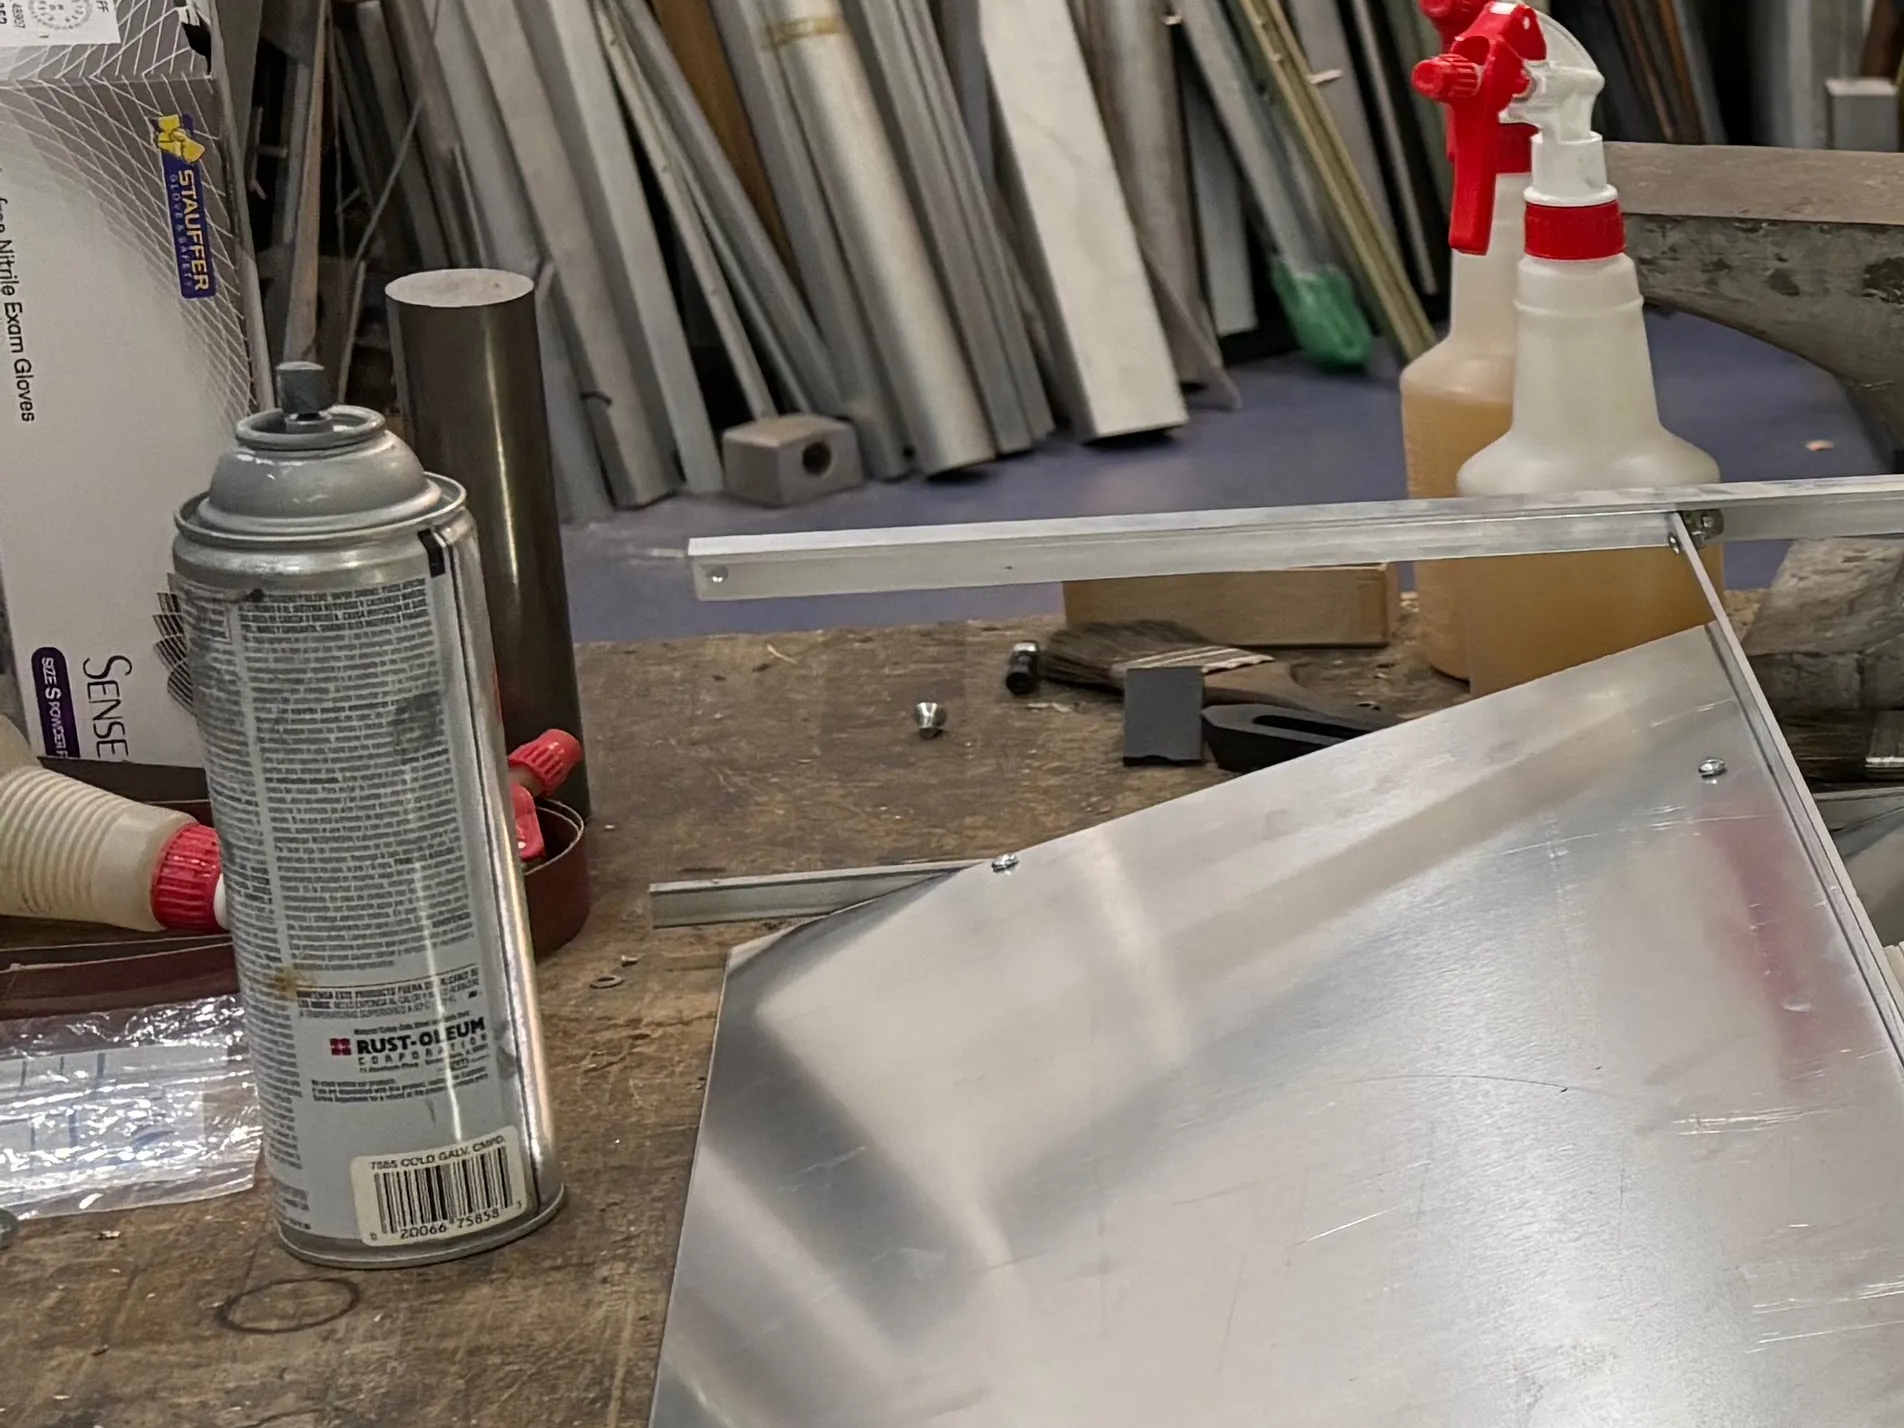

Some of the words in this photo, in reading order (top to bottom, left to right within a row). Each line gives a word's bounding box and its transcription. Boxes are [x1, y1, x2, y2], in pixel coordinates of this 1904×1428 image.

[177, 168, 210, 291] STAUFFER
[0, 239, 20, 297] Nitrile
[4, 301, 24, 354] Exam
[14, 357, 36, 423] Gloves
[41, 656, 58, 685] SIZE
[45, 686, 62, 700] S
[83, 655, 132, 759] SENSE
[356, 1016, 486, 1056] RUST-OLEUM
[400, 1222, 448, 1241] 20066
